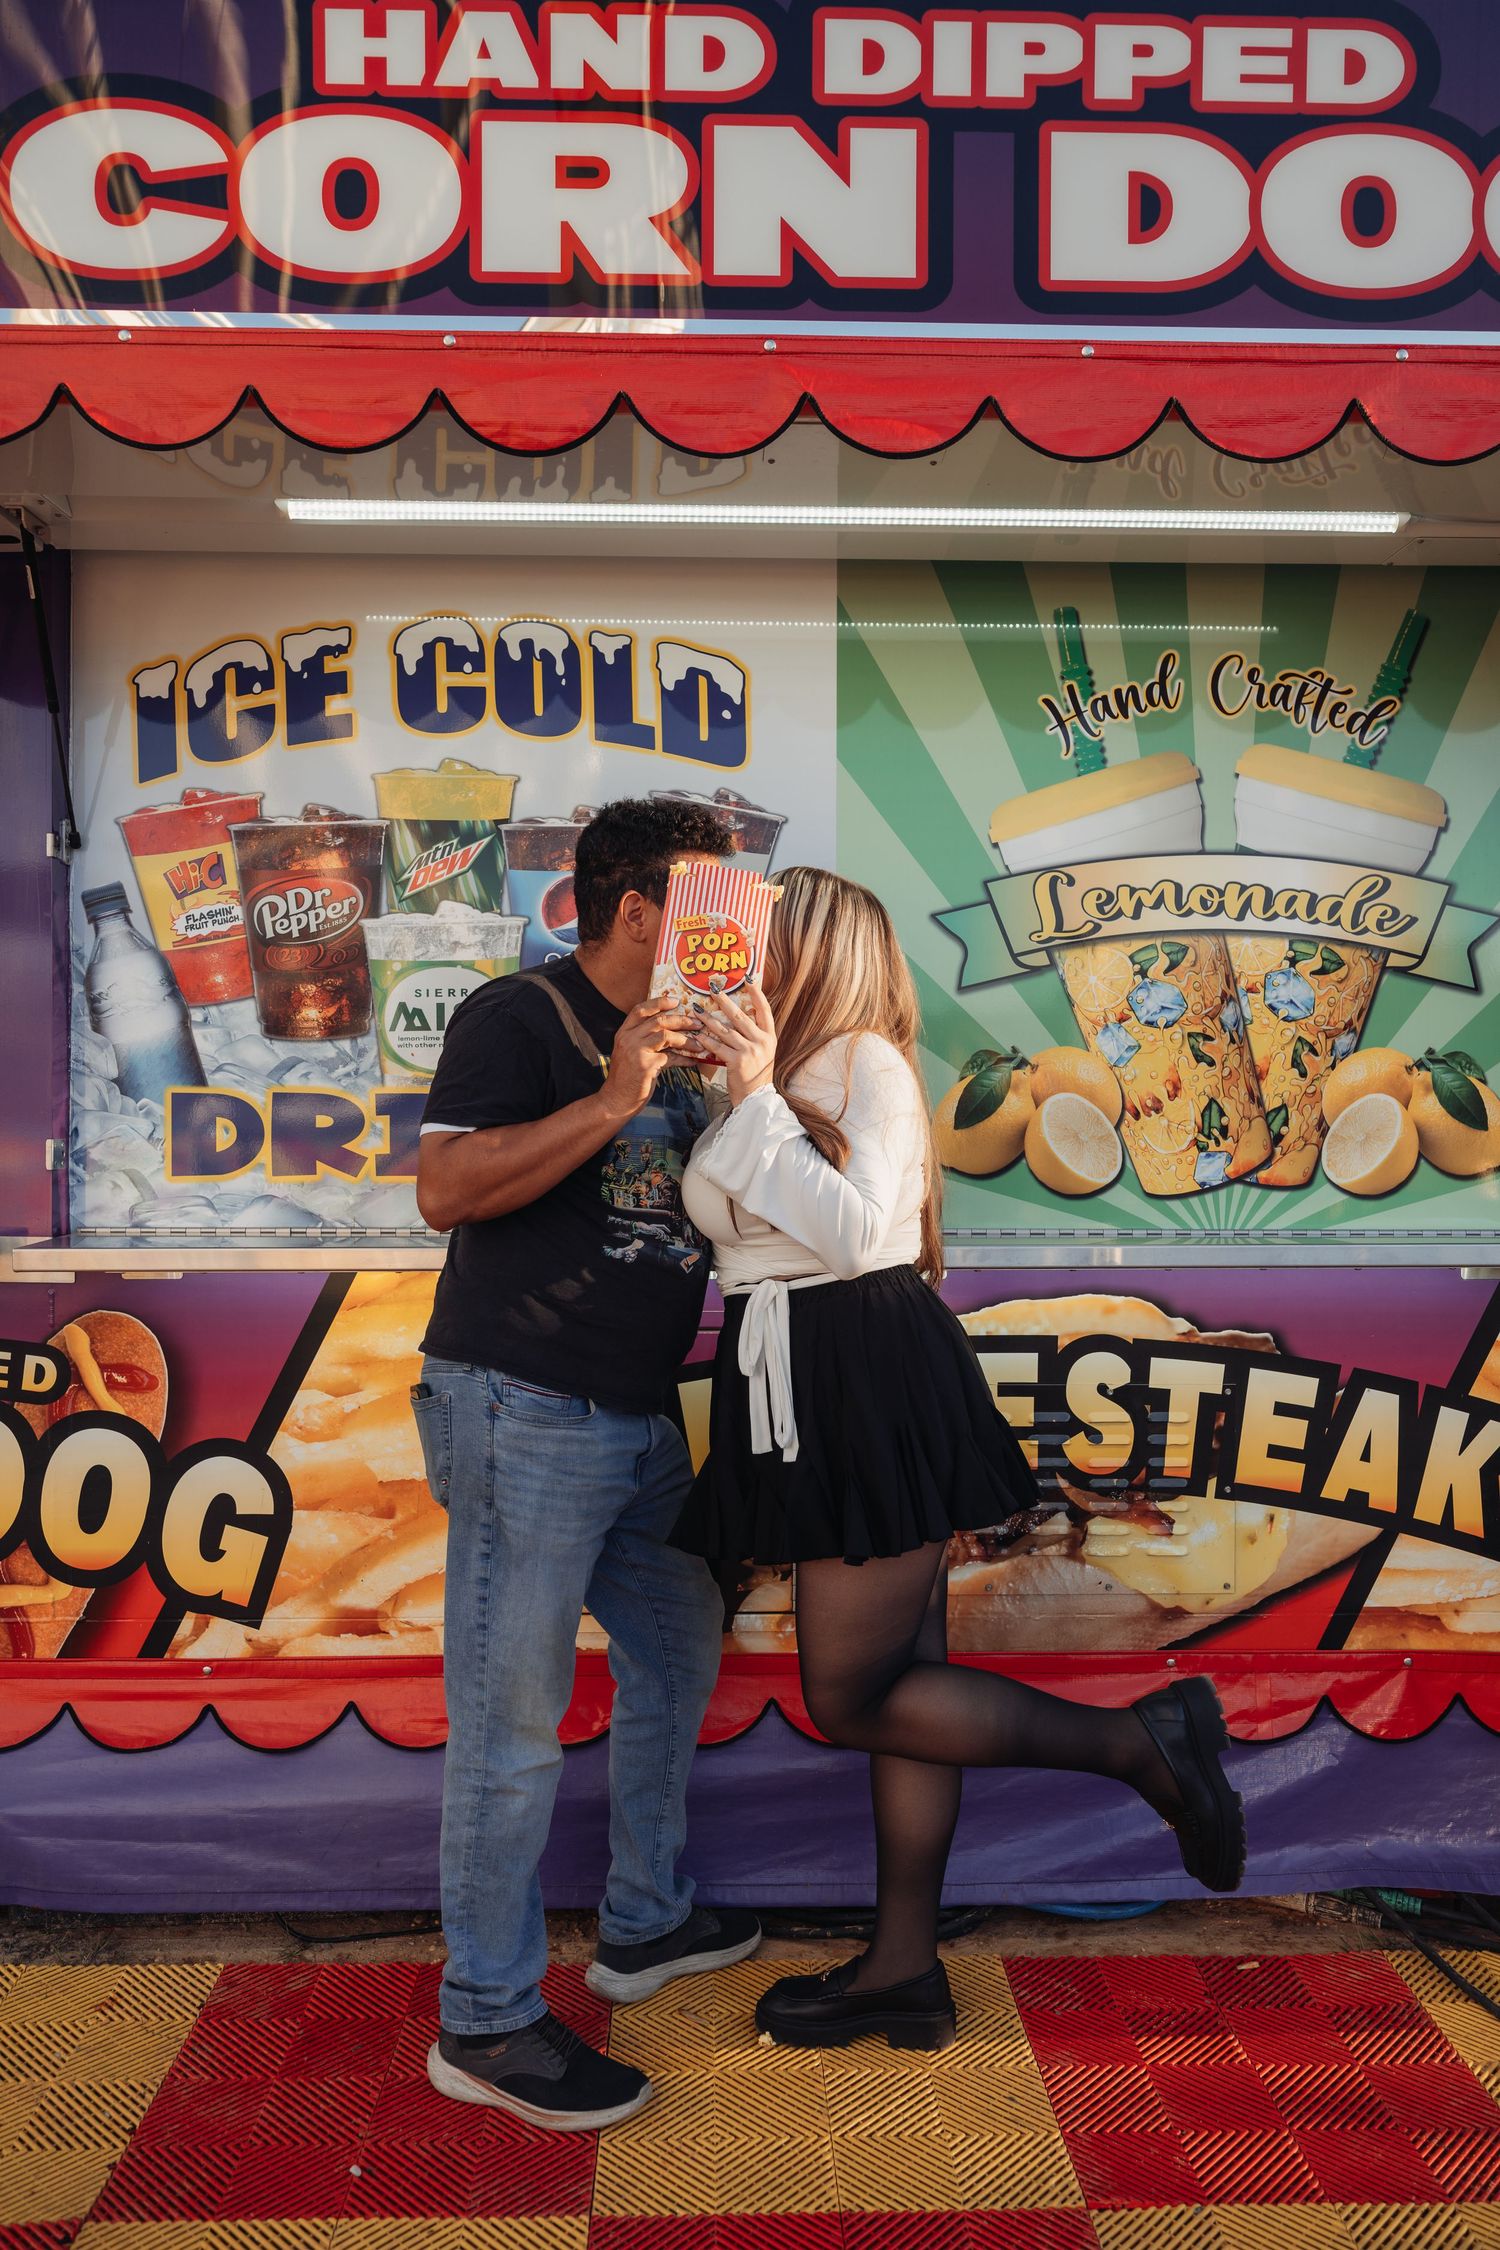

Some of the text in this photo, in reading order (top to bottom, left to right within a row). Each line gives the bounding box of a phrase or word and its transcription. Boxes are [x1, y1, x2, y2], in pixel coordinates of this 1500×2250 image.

[313, 2, 1416, 115] HAND DIPPED
[0, 97, 1500, 300] CORN DO
[129, 611, 751, 786] ICE COLD
[1042, 651, 1400, 756] Hand Crafted
[184, 915, 240, 933] FRUIT PUNCH
[185, 906, 235, 925] FLASHIN'
[254, 887, 356, 940] Dr Pepper
[676, 914, 707, 930] Fresh
[1028, 870, 1419, 942] Lemonade
[687, 932, 738, 953] POP
[680, 950, 748, 975] CORN
[414, 988, 469, 998] SIERR
